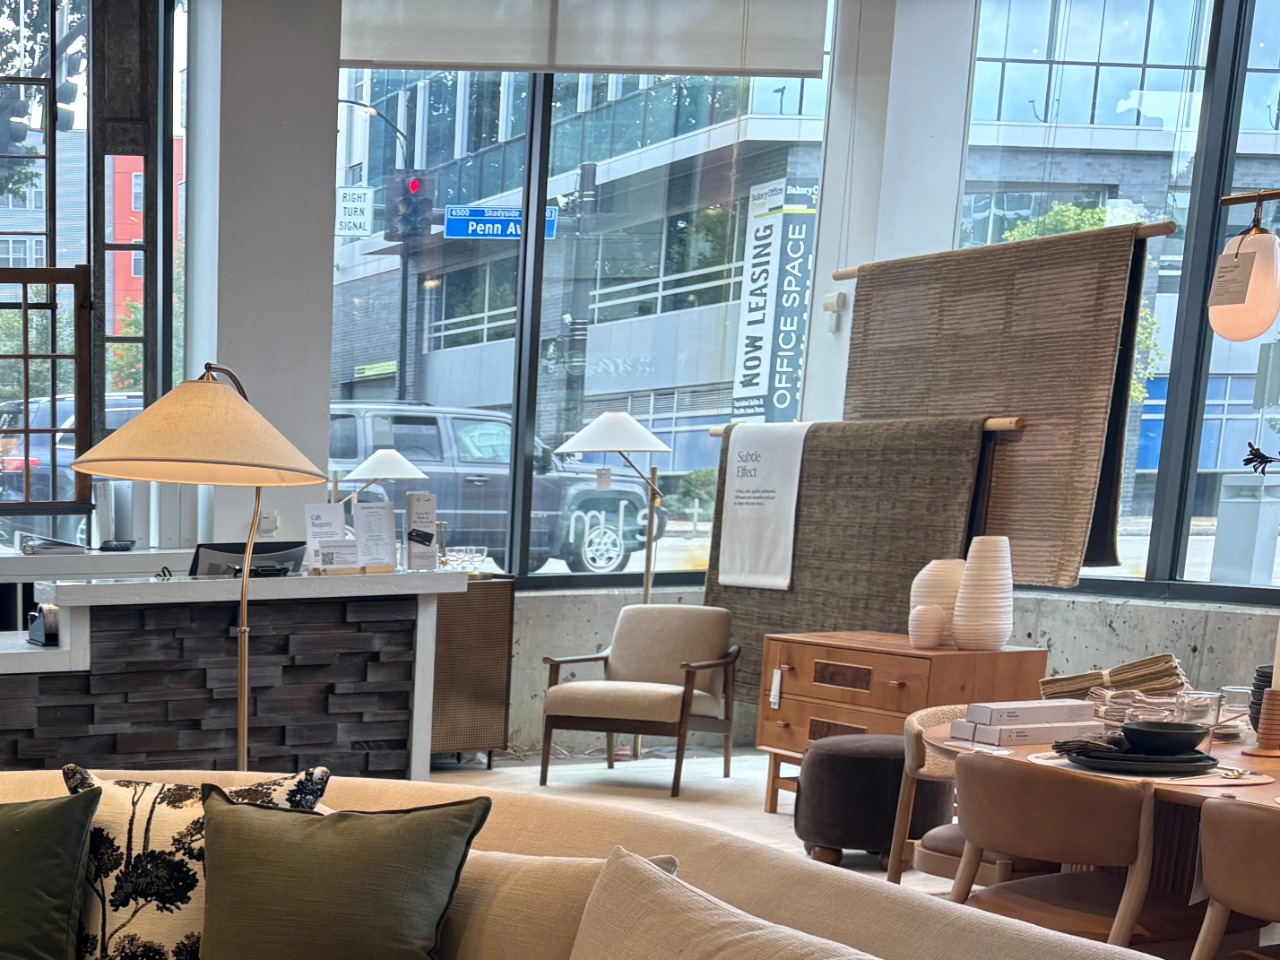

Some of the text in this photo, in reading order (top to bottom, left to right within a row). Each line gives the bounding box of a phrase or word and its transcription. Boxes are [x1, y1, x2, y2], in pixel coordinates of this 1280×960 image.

[342, 193, 367, 203] RIGHT
[342, 207, 365, 217] TURN
[452, 208, 470, 217] 6500
[483, 209, 519, 219] Shadyside
[339, 221, 368, 231] SIGNAL
[468, 221, 502, 235] Penn
[782, 223, 807, 308] SPACE
[747, 223, 774, 327] LEASING
[739, 335, 764, 389] NOW
[773, 315, 798, 409] OFFICE
[737, 450, 762, 463] Subtle
[736, 465, 758, 478] Effect
[311, 521, 333, 529] Registry
